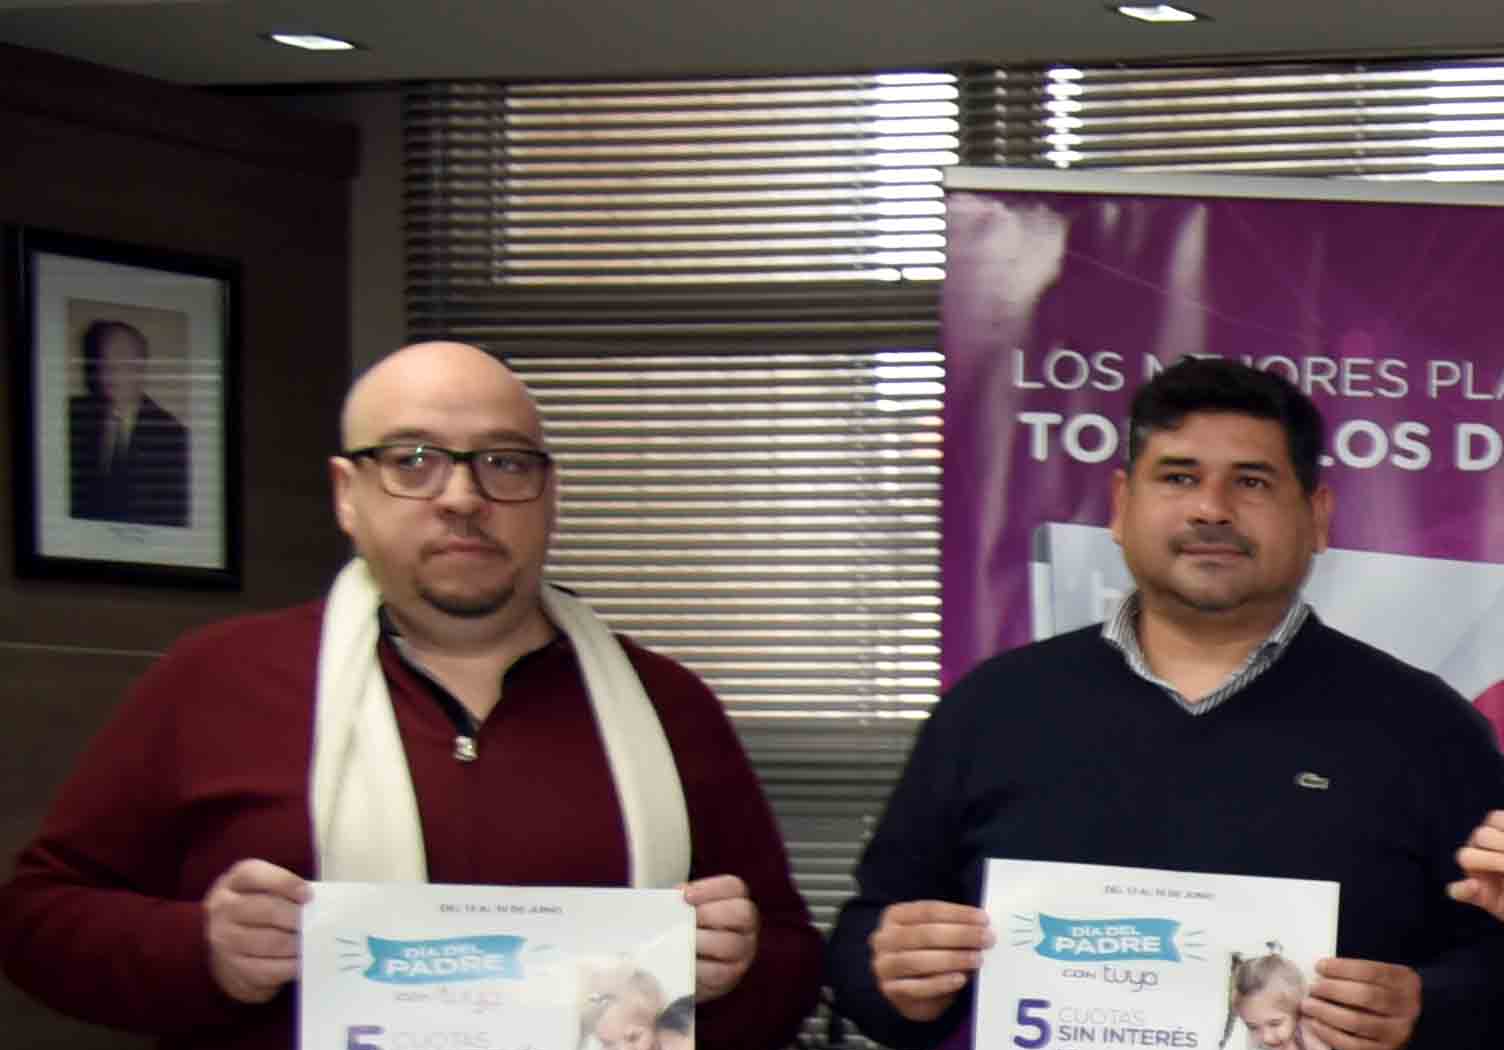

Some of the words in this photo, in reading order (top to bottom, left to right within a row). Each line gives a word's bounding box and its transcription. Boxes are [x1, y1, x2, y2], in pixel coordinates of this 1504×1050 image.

[1011, 350, 1126, 391] LOS
[1320, 418, 1431, 472] OS
[1054, 928, 1162, 959] PADRE
[1106, 923, 1143, 937] DEL
[1013, 997, 1052, 1050] 5
[1058, 1025, 1095, 1042] SIN
[1101, 1021, 1198, 1048] INTERÉS
